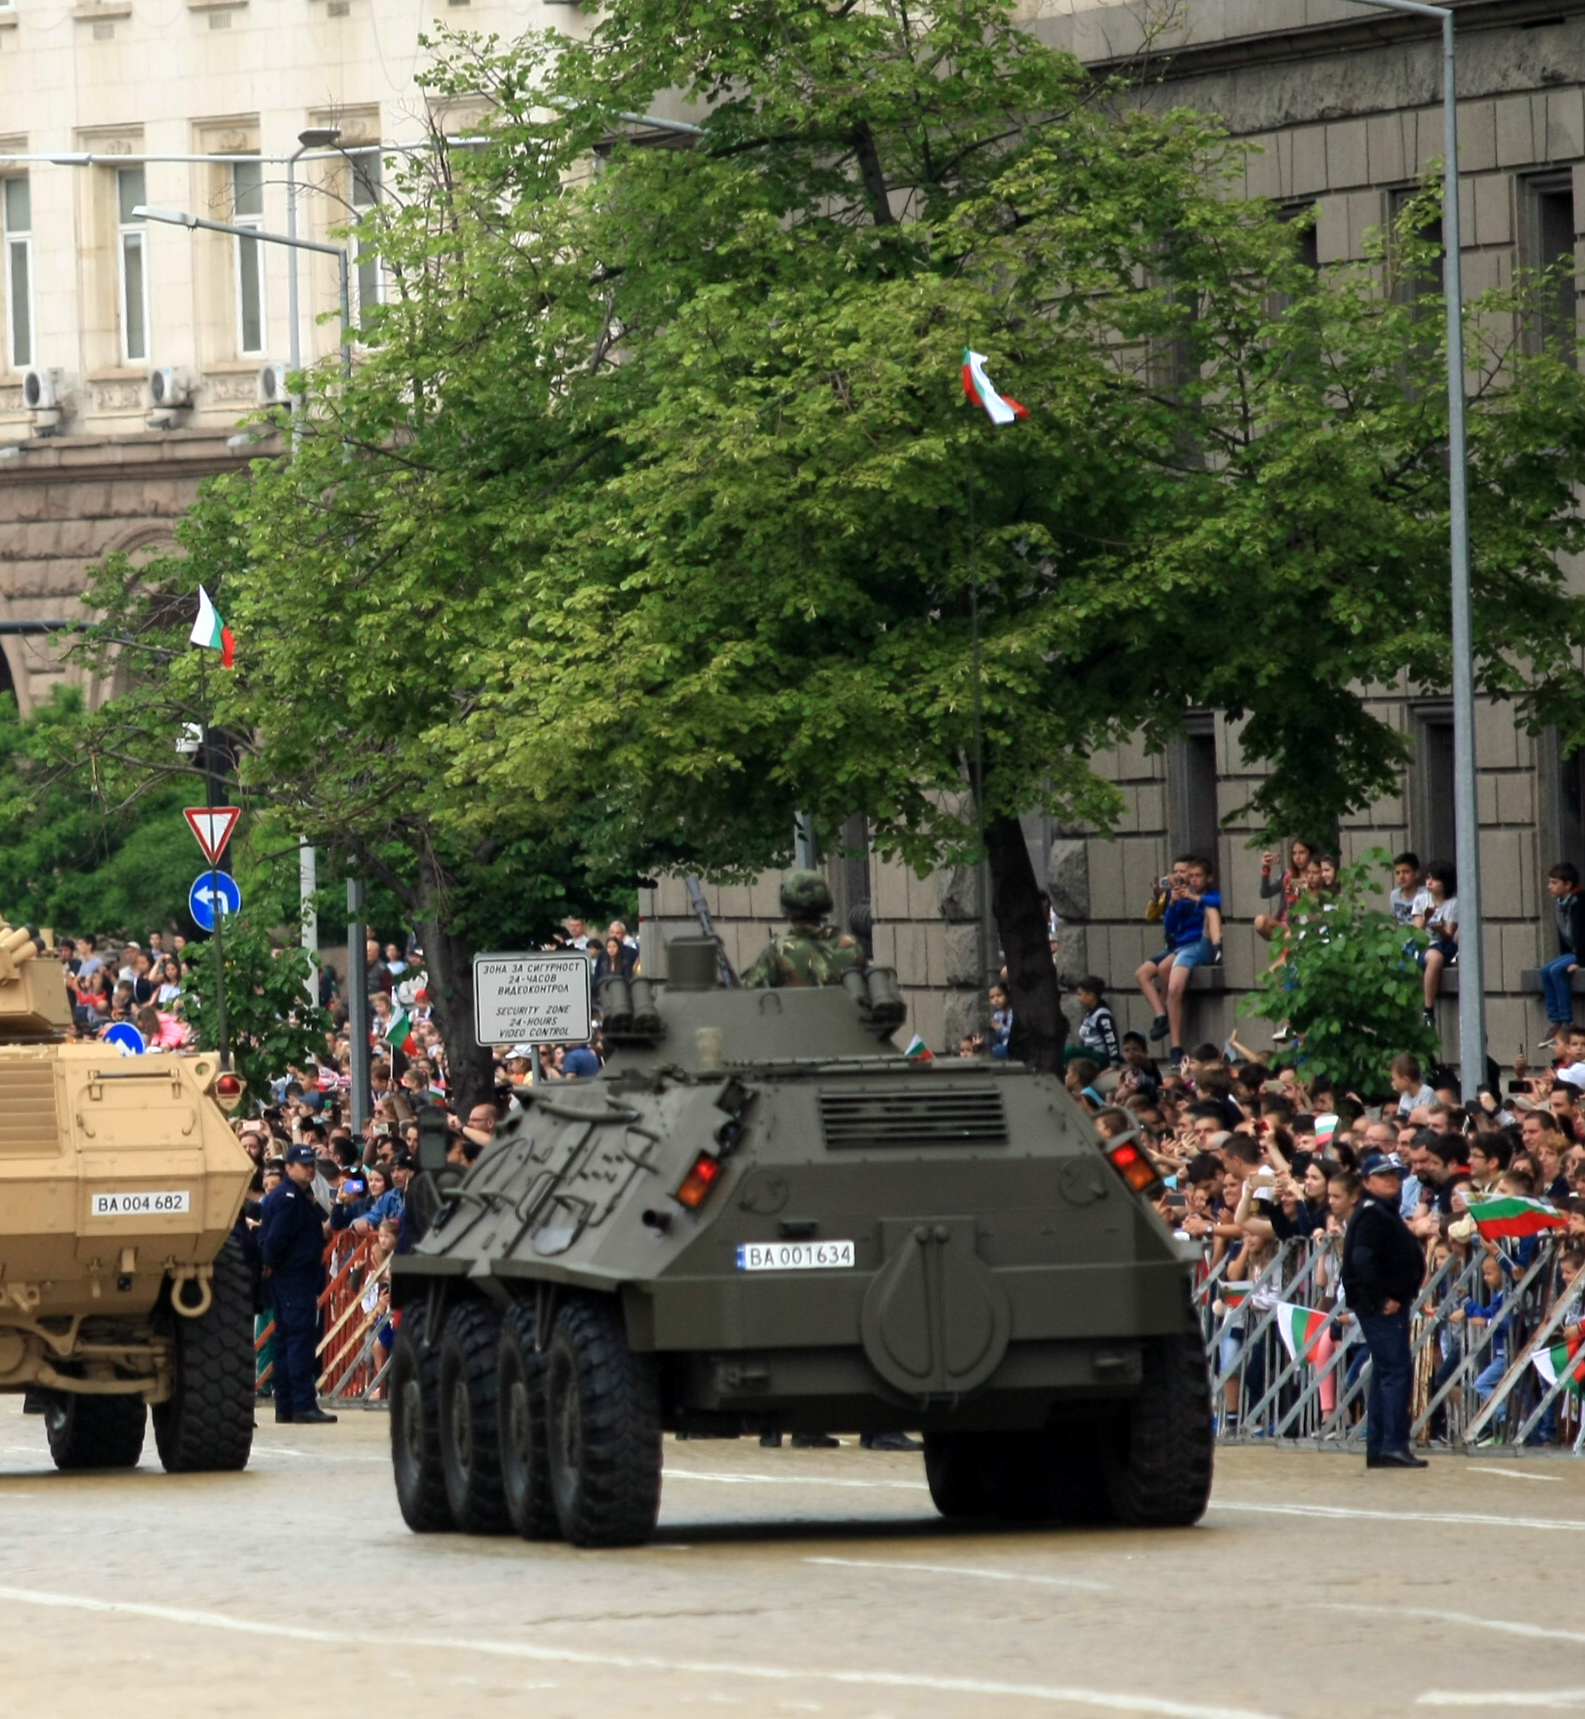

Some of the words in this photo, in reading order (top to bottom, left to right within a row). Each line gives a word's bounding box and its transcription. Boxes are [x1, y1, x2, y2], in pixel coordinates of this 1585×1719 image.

[483, 965, 507, 974] ЗОНА
[512, 964, 523, 973] ЗА
[527, 963, 580, 973] СИГУРНОСТ
[509, 974, 557, 984] 24-ЧАСОВ
[497, 984, 569, 996] ВИДЕОКОНТРОЛ
[495, 1006, 540, 1016] SECURITY
[546, 1005, 571, 1014] ZONE
[509, 1017, 558, 1027] 24-HOURS
[499, 1029, 526, 1038] VIDEO
[529, 1027, 570, 1037] CONTROL
[98, 1197, 118, 1212] BA
[122, 1197, 150, 1211] 004
[155, 1195, 183, 1210] 682
[750, 1247, 775, 1267] BA
[780, 1245, 851, 1265] 001634
